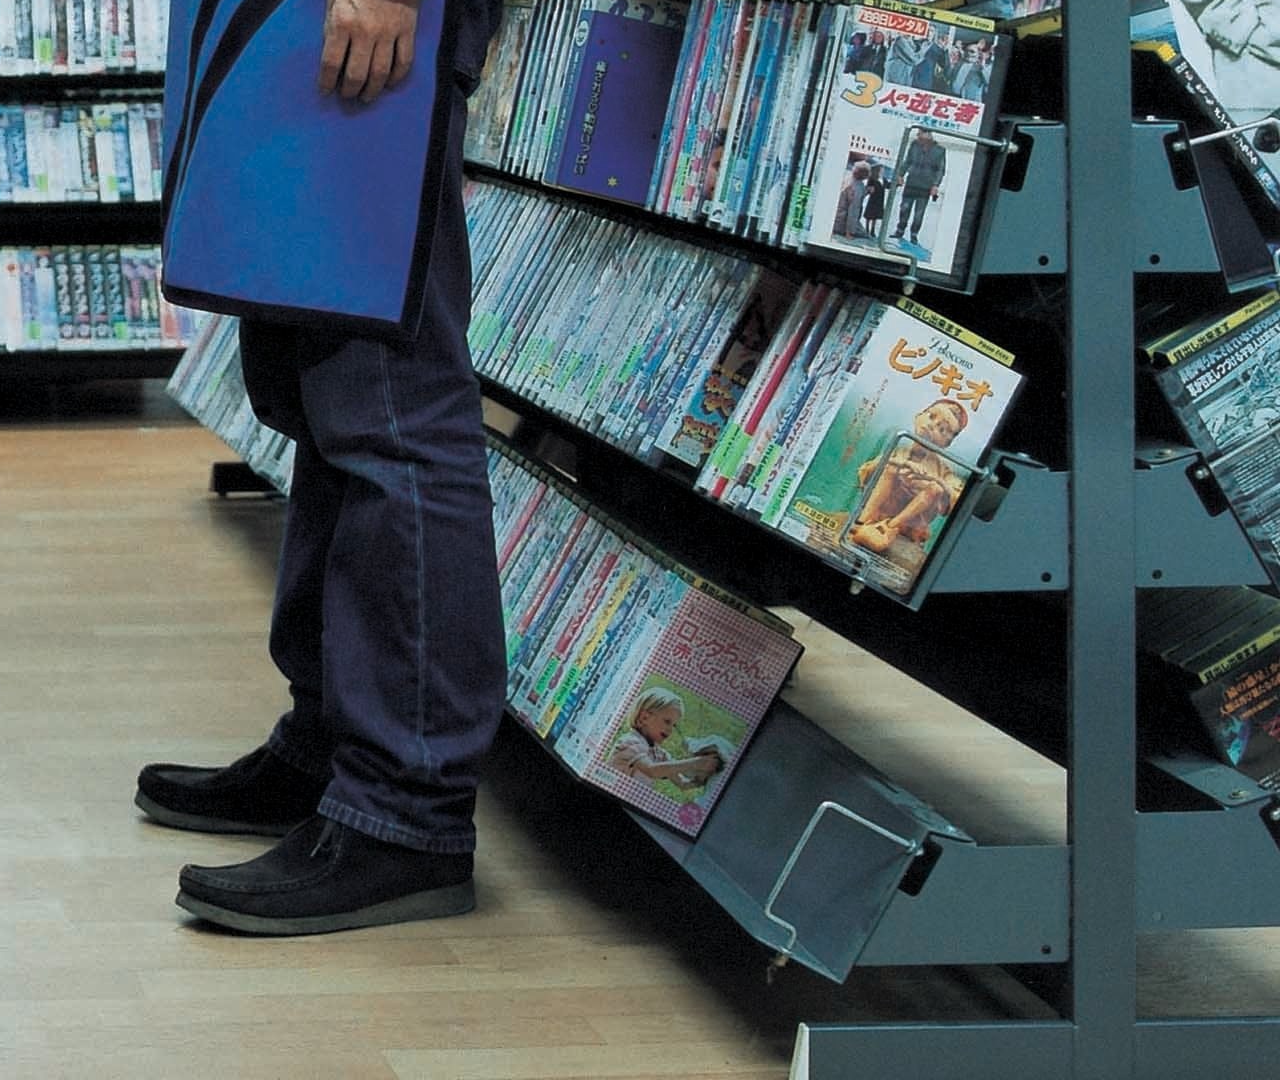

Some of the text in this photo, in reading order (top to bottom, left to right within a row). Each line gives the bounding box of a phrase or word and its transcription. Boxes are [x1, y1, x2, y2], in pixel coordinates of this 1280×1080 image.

[841, 70, 982, 125] 3人の逃亡者
[888, 338, 994, 412] ピノキオ
